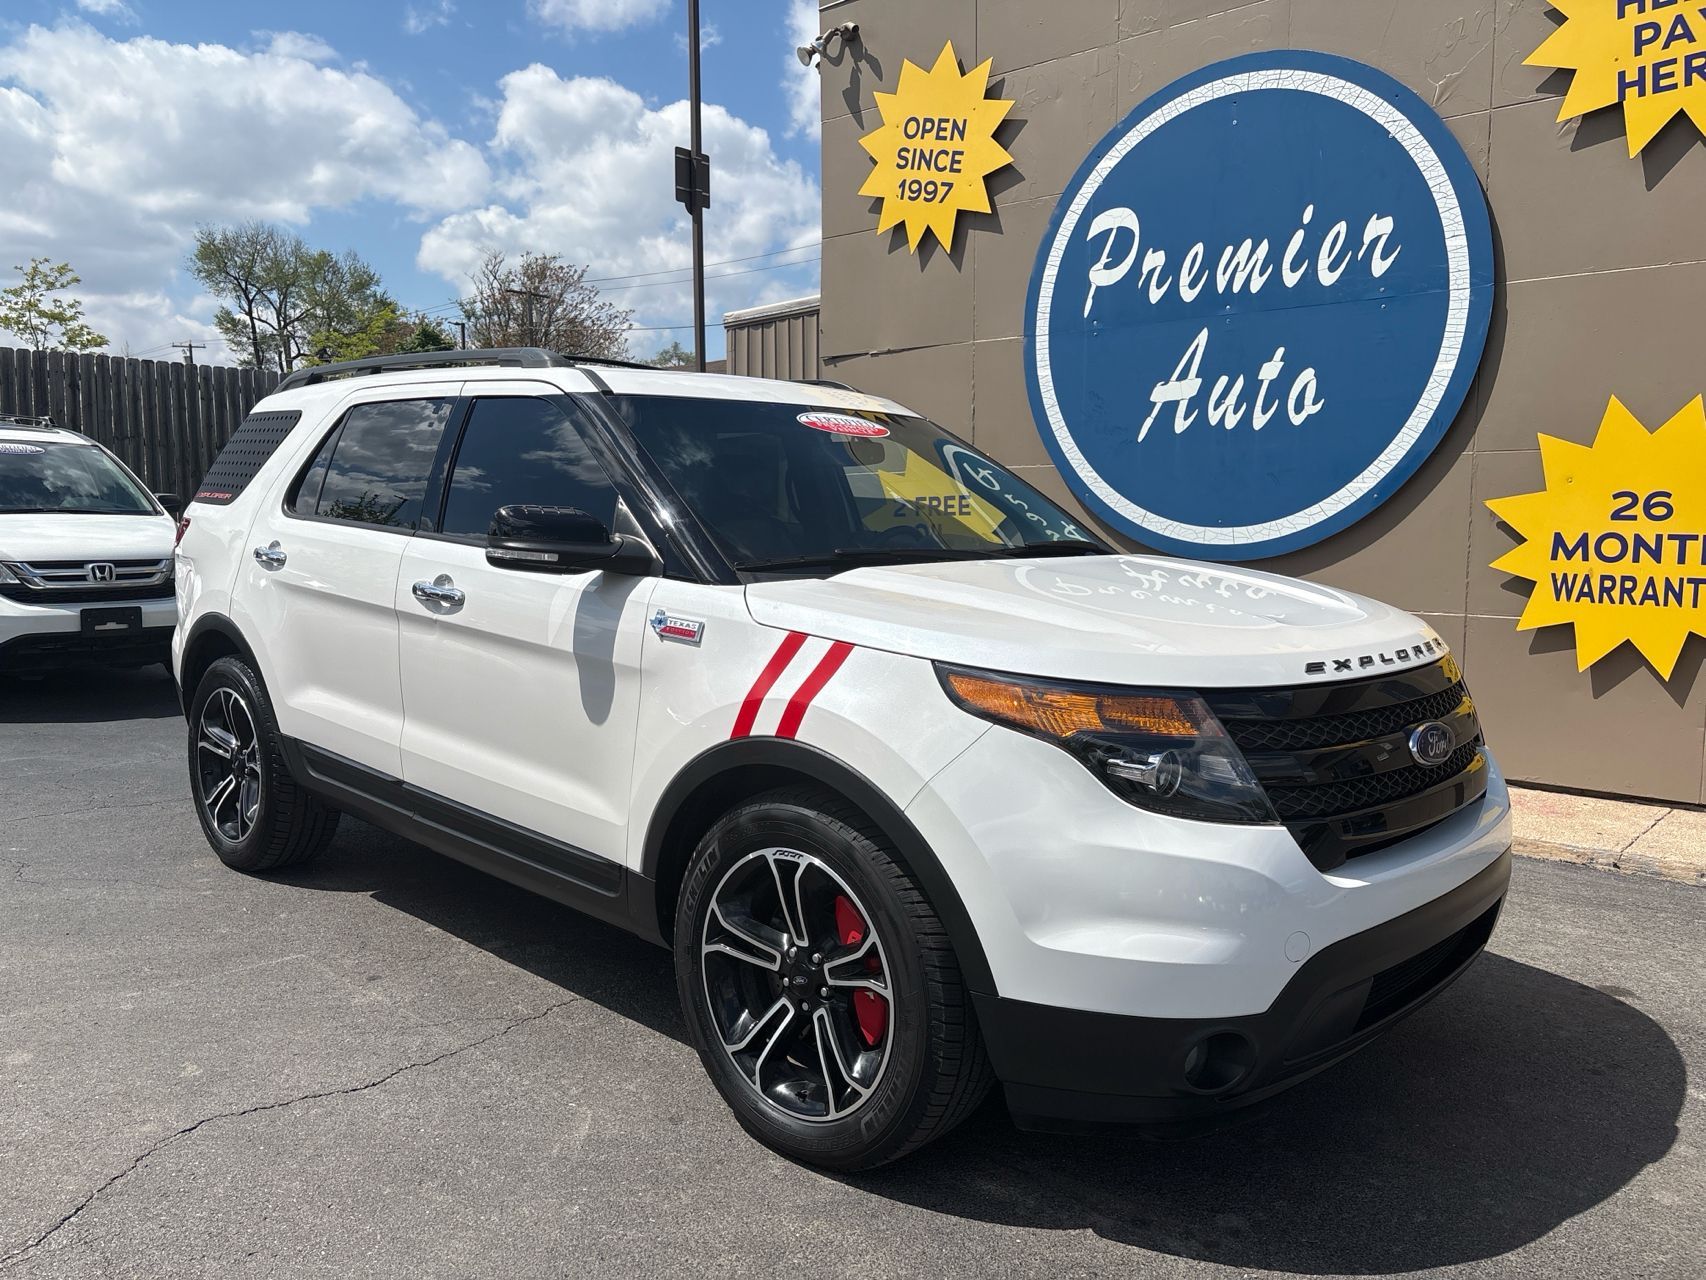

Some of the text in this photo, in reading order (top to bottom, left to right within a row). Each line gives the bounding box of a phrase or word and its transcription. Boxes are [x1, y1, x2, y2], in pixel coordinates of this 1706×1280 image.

[1634, 8, 1706, 57] PA
[1617, 51, 1706, 102] HER
[903, 116, 967, 141] OPEN
[896, 147, 965, 173] SINCE
[898, 179, 954, 204] 1997
[1084, 204, 1401, 318] Premier
[1137, 327, 1325, 443] Auto
[916, 495, 972, 516] FREE
[1610, 491, 1674, 522] 26
[1550, 532, 1706, 566] MONT
[1550, 573, 1706, 609] WARRANT
[669, 619, 697, 629] TEXAS
[1305, 637, 1446, 676] EXPLORER
[1427, 729, 1450, 757] Ford
[772, 849, 804, 860] SPORT
